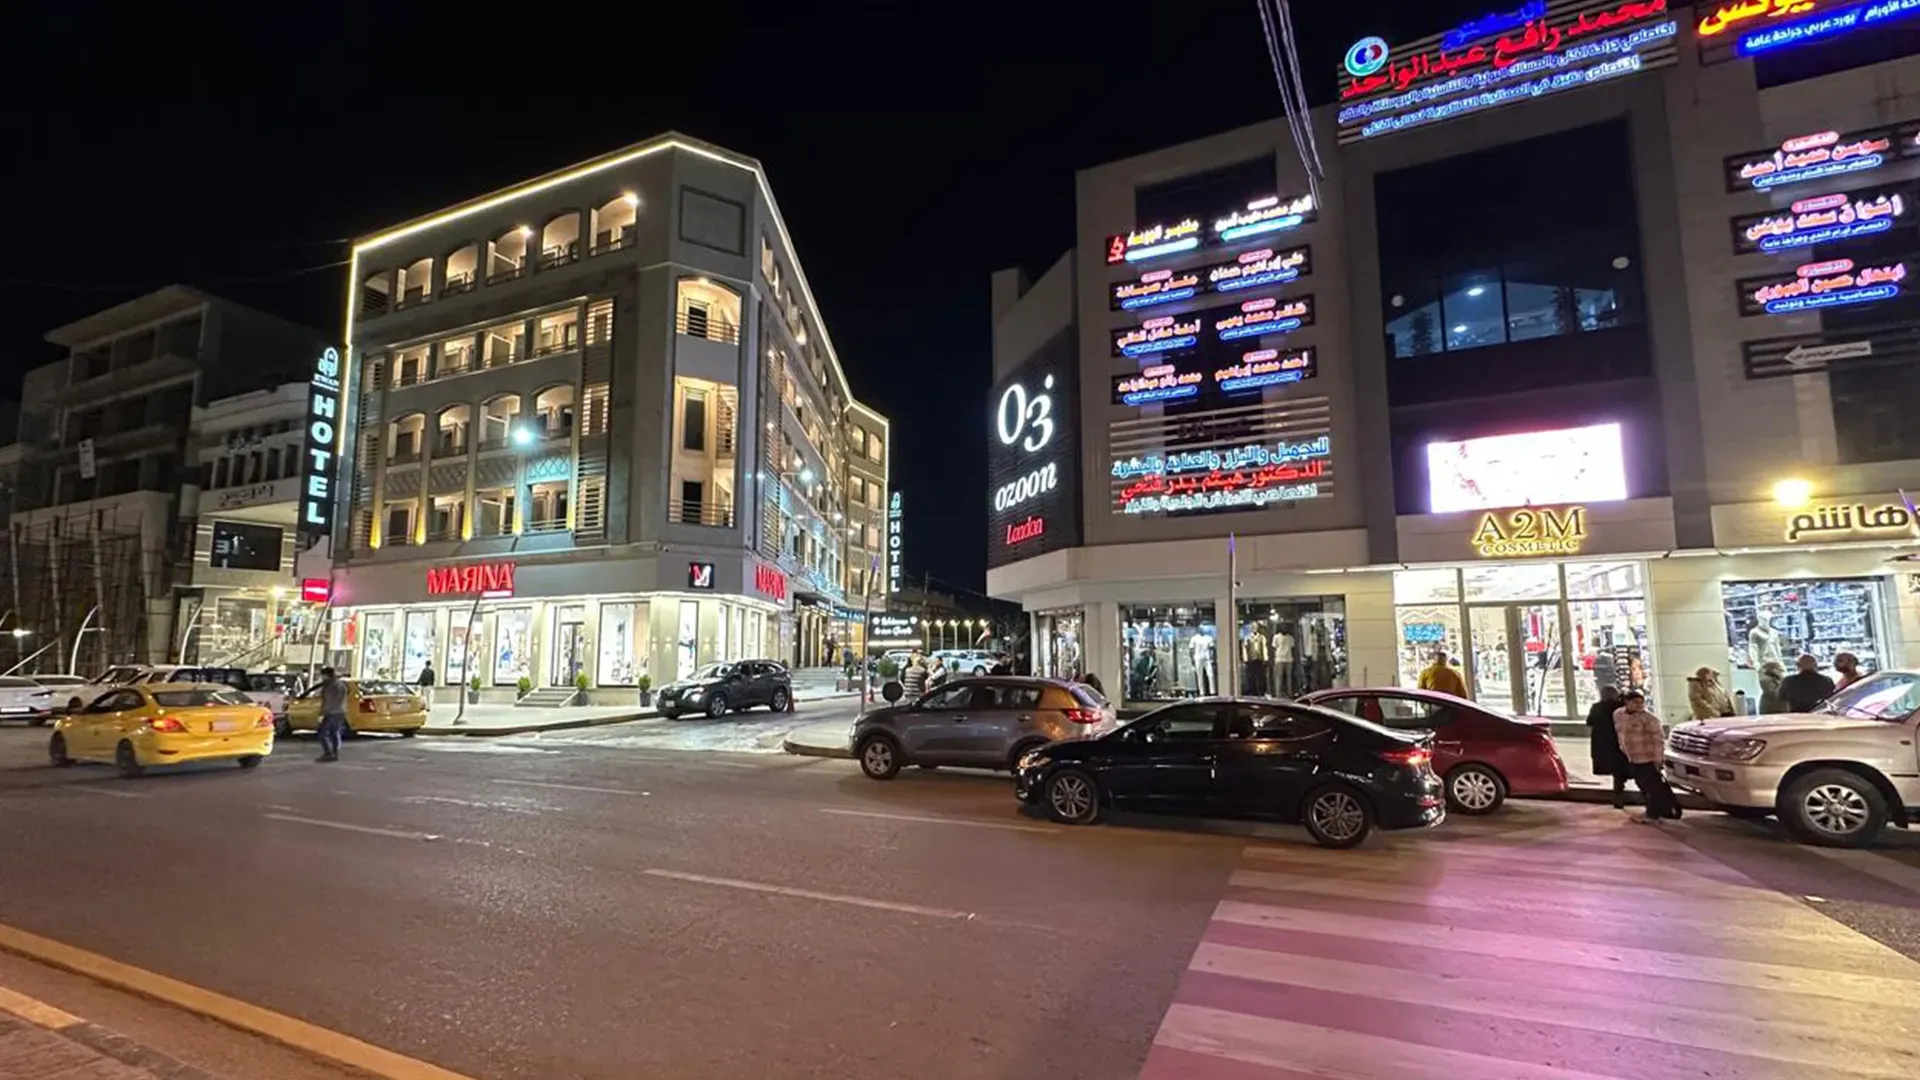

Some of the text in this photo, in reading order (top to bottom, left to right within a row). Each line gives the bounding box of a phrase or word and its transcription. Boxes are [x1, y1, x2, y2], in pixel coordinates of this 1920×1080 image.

[1568, 0, 1667, 36] محمد
[1493, 20, 1561, 67] رافع
[307, 394, 334, 525] HOTEL
[1248, 461, 1323, 488] الدكتور
[995, 462, 1057, 512] ozoon
[1006, 516, 1043, 544] London
[1473, 507, 1586, 544] A2M
[1788, 505, 1909, 540] هاشم
[890, 520, 901, 593] HOTEL
[1483, 541, 1578, 554] COSMETIC
